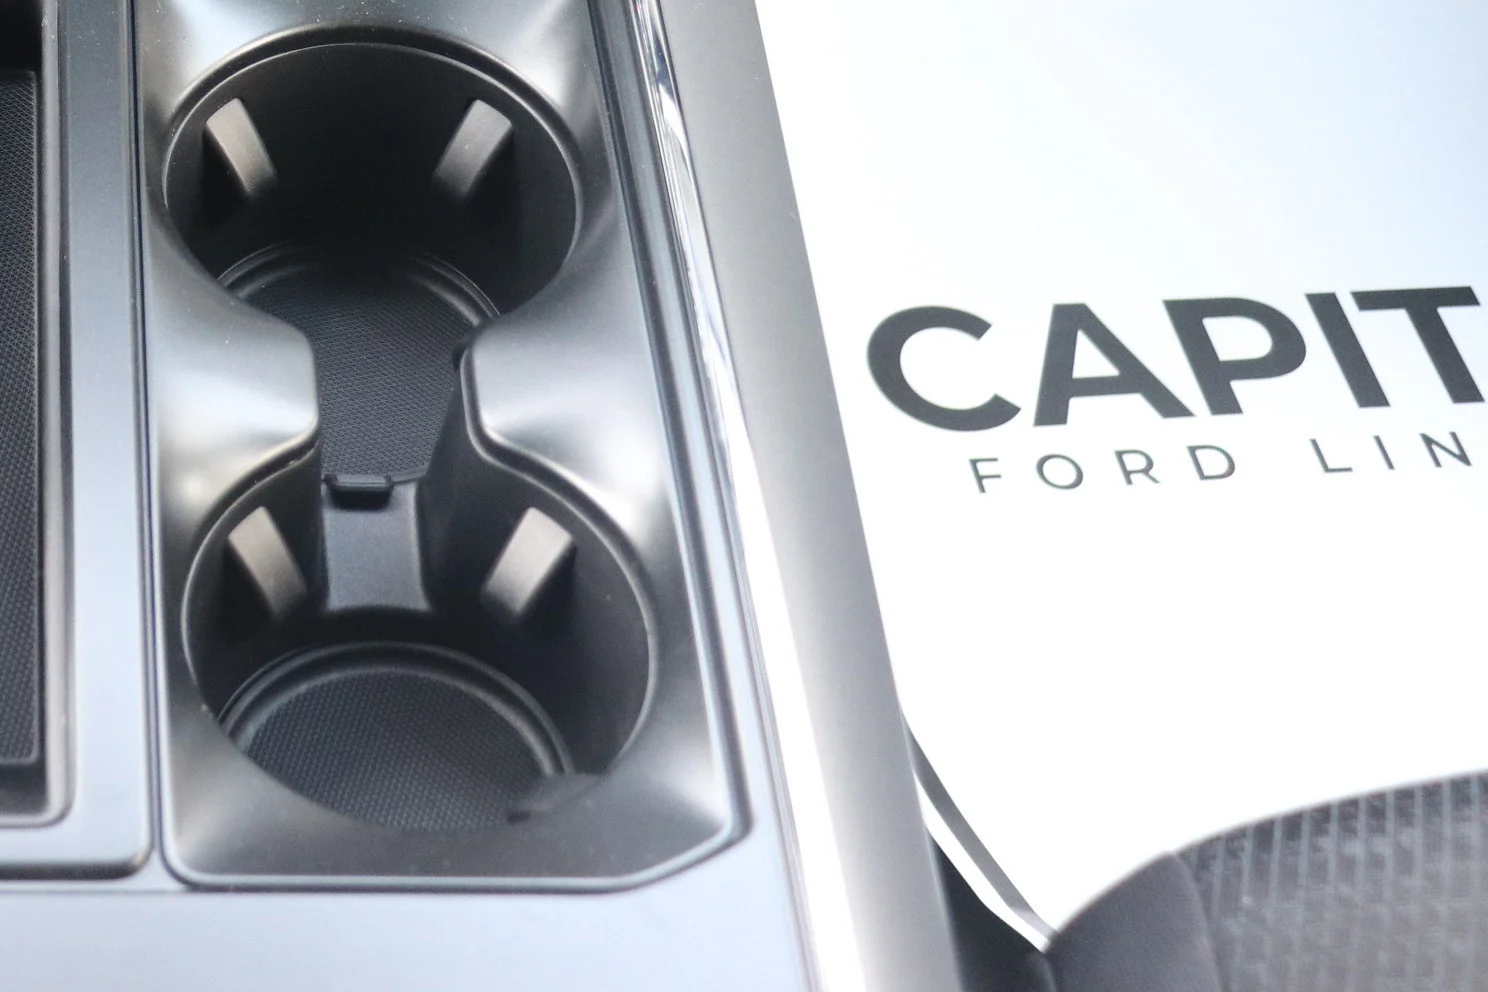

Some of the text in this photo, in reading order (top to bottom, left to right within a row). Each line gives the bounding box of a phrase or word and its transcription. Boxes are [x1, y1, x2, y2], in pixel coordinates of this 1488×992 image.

[866, 285, 1486, 432] CAPIT
[969, 431, 1473, 494] FORD LIN
